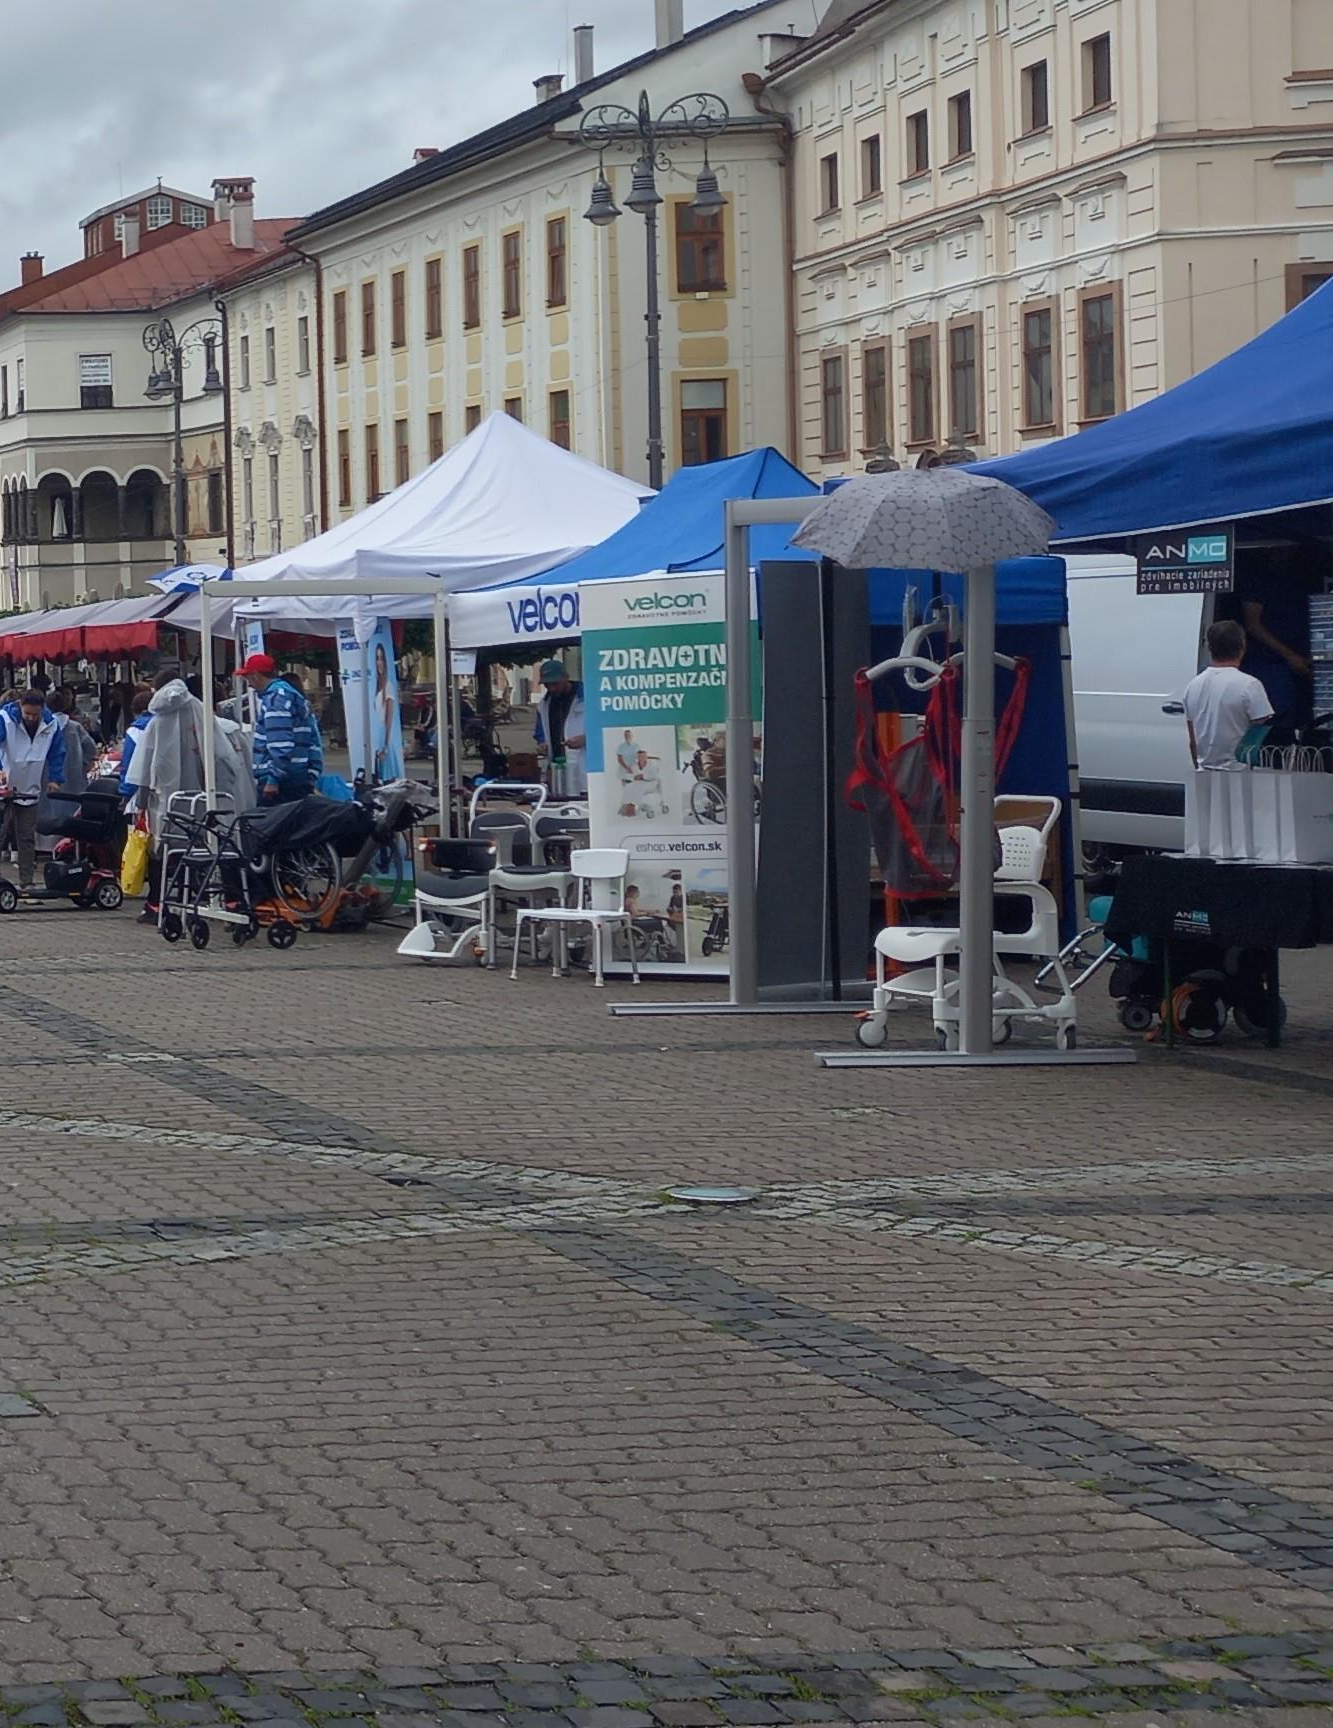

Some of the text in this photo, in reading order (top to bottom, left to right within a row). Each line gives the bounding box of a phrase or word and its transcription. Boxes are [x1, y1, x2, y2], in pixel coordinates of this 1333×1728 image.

[1145, 542, 1227, 559] ANMO
[1187, 567, 1230, 579] zariadenia
[1140, 583, 1160, 593] pre
[506, 587, 580, 634] velco
[623, 592, 707, 611] velcon
[598, 643, 727, 671] ZDRAVOTN
[599, 667, 727, 691] A KOMPENZAČ
[601, 691, 685, 712] POMÔCKY
[635, 841, 722, 853] eshop.velcon.sk
